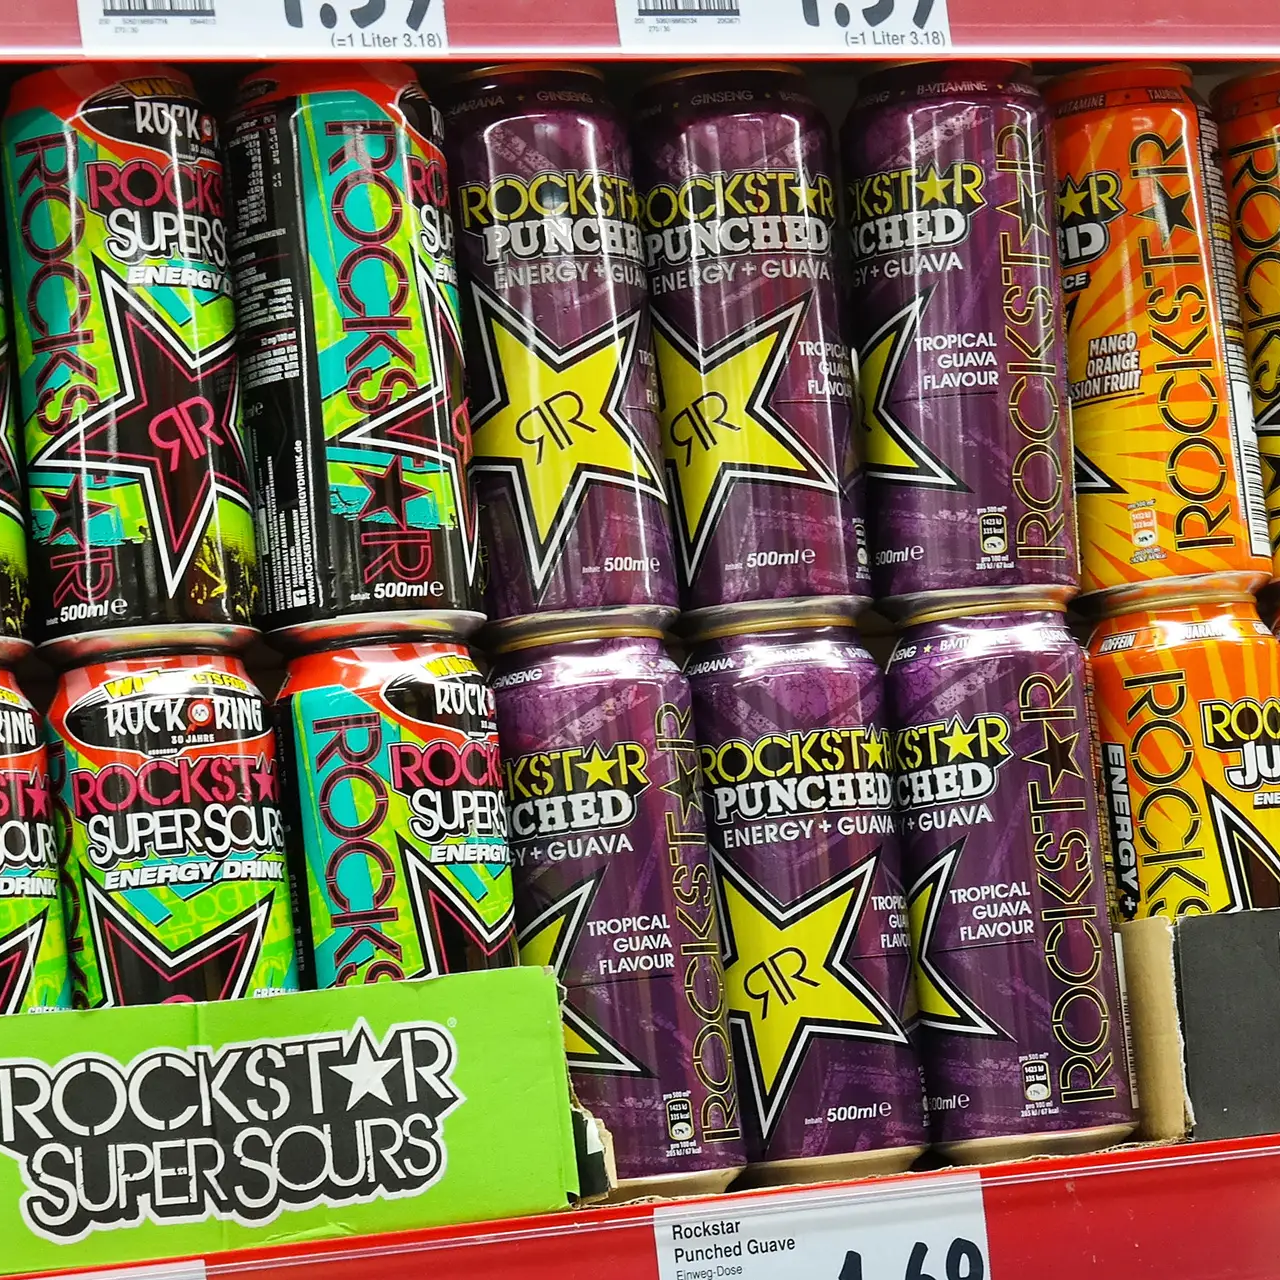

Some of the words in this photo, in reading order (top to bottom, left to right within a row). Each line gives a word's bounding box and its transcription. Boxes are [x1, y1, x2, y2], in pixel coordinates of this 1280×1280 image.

[361, 33, 397, 48] Liter
[402, 33, 442, 48] 3.18)
[875, 30, 906, 46] Liter
[910, 30, 946, 46] 3.18)
[916, 80, 988, 95] B-VITAMINE
[914, 331, 997, 352] TROPICAL
[1089, 331, 1137, 355] MANGO
[937, 350, 998, 369] GUAVA
[1086, 351, 1139, 375] ORANGE
[923, 369, 1000, 389] FLAVOUR
[1104, 369, 1142, 391] FRUIT
[214, 694, 263, 733] RING
[715, 772, 891, 822] PUNCHED
[723, 818, 813, 849] ENERGY
[105, 863, 218, 890] ENERGY
[222, 858, 285, 883] DRINK
[949, 883, 1031, 904] TROPICAL
[973, 901, 1032, 920] GUAVA
[586, 914, 670, 937] TROPICAL
[959, 919, 1035, 942] FLAVOUR
[613, 933, 673, 953] GUAVA
[598, 953, 675, 974] FLAVOUR
[672, 1219, 741, 1241] Rockstar
[674, 1245, 742, 1264] Punched
[747, 1236, 796, 1255] Guave
